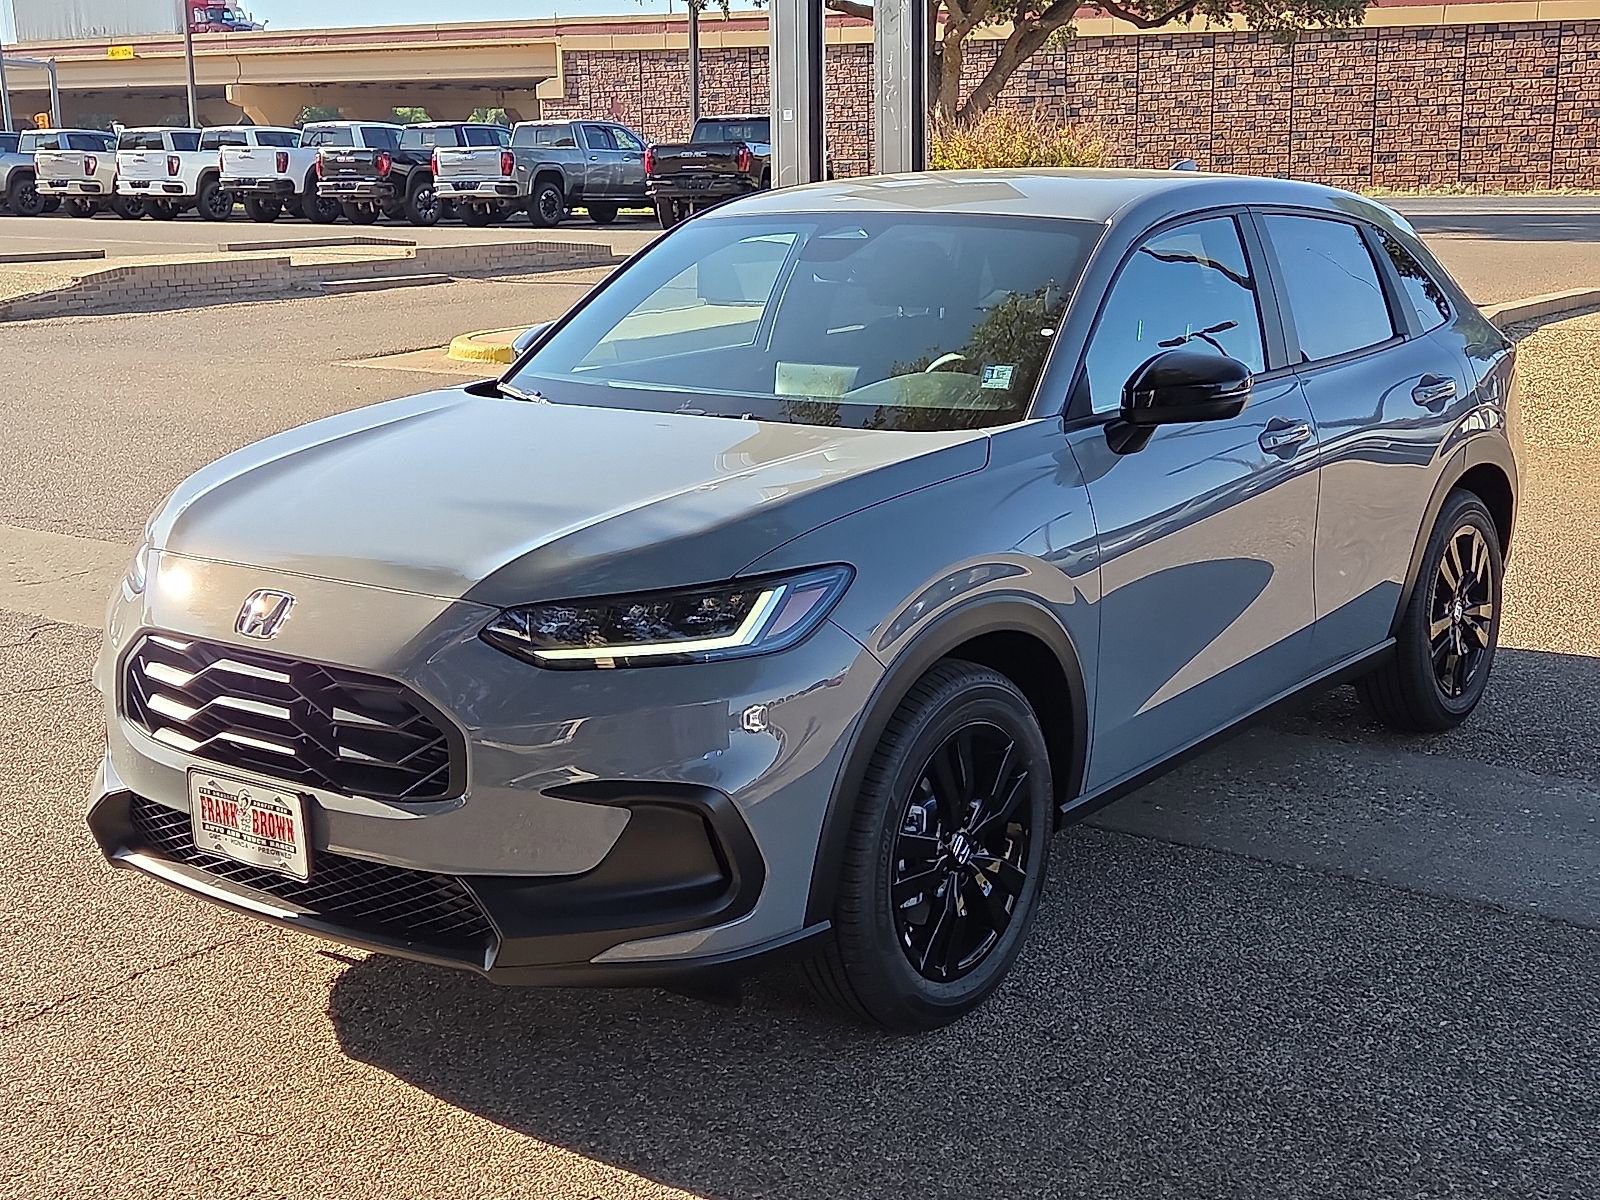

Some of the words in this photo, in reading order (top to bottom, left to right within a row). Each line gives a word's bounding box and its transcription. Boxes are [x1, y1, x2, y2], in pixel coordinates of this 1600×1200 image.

[200, 795, 239, 829] FRANK
[252, 809, 295, 844] BROWN
[204, 823, 224, 833] AUTO
[225, 828, 240, 838] AND
[241, 833, 266, 845] TRUCK
